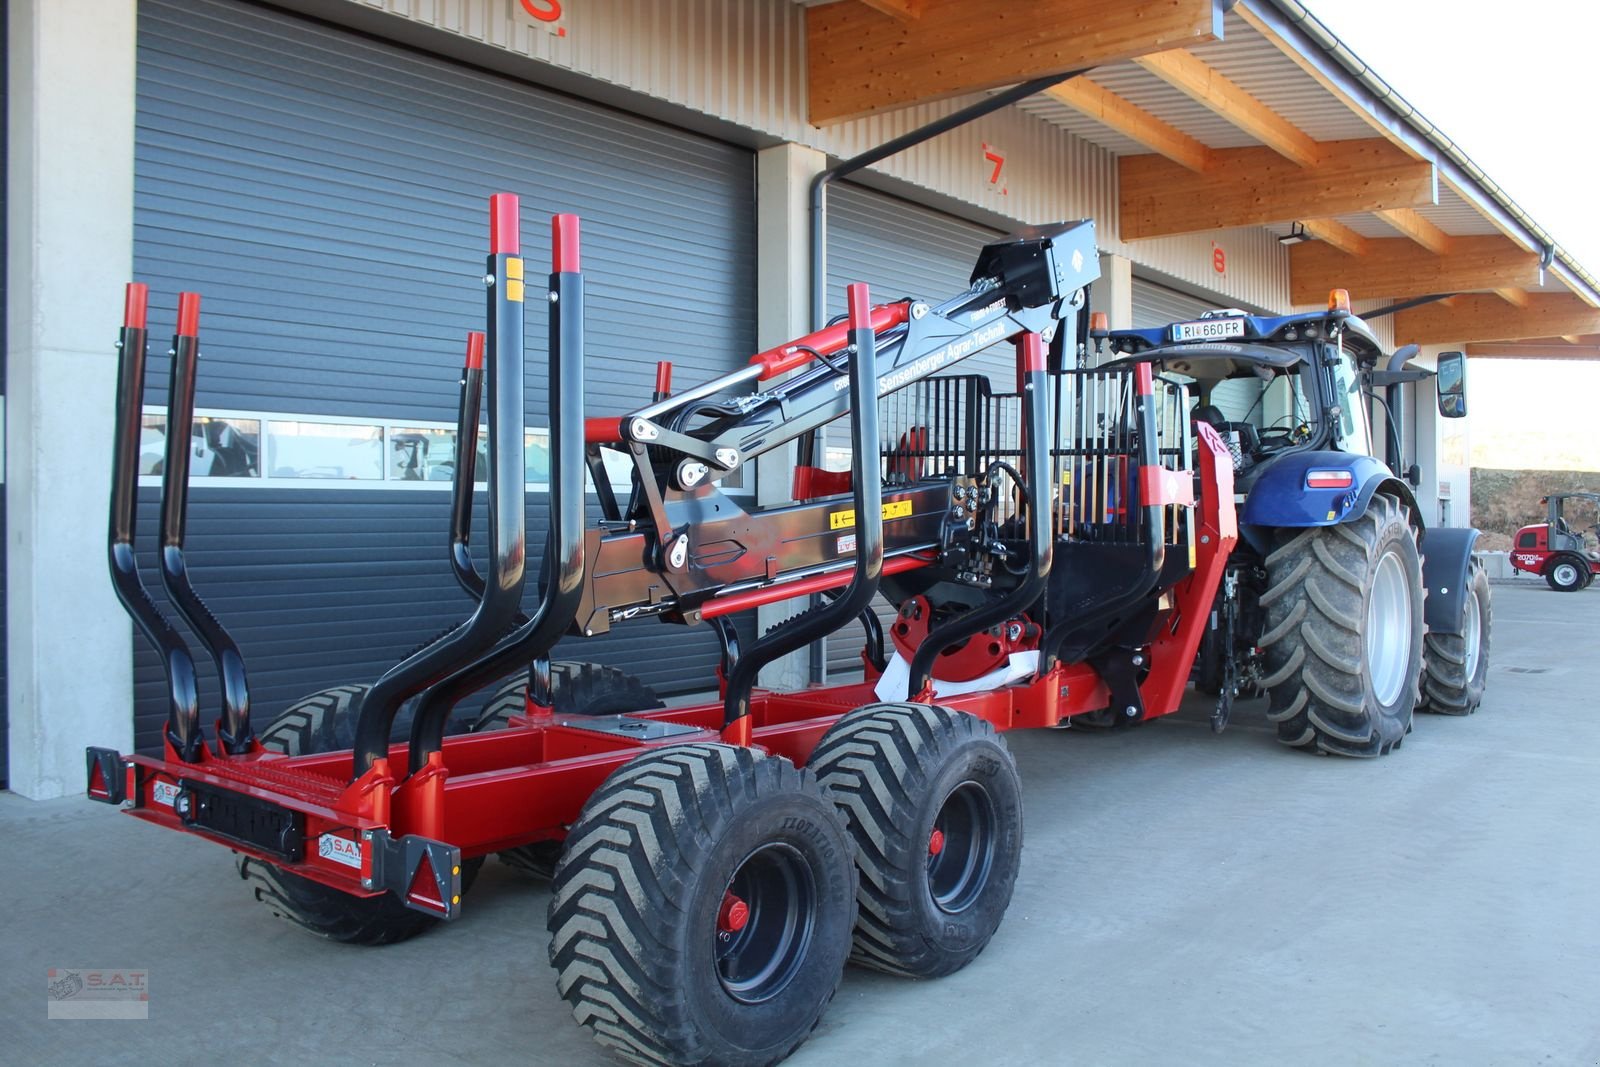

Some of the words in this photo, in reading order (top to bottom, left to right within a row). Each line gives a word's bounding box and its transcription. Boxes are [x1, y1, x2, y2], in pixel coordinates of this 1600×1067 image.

[985, 152, 1004, 184] 7
[1213, 247, 1225, 273] 8
[1184, 326, 1195, 338] RI
[879, 349, 945, 394] Sensenberger
[947, 323, 1006, 359] Agrar-Technik
